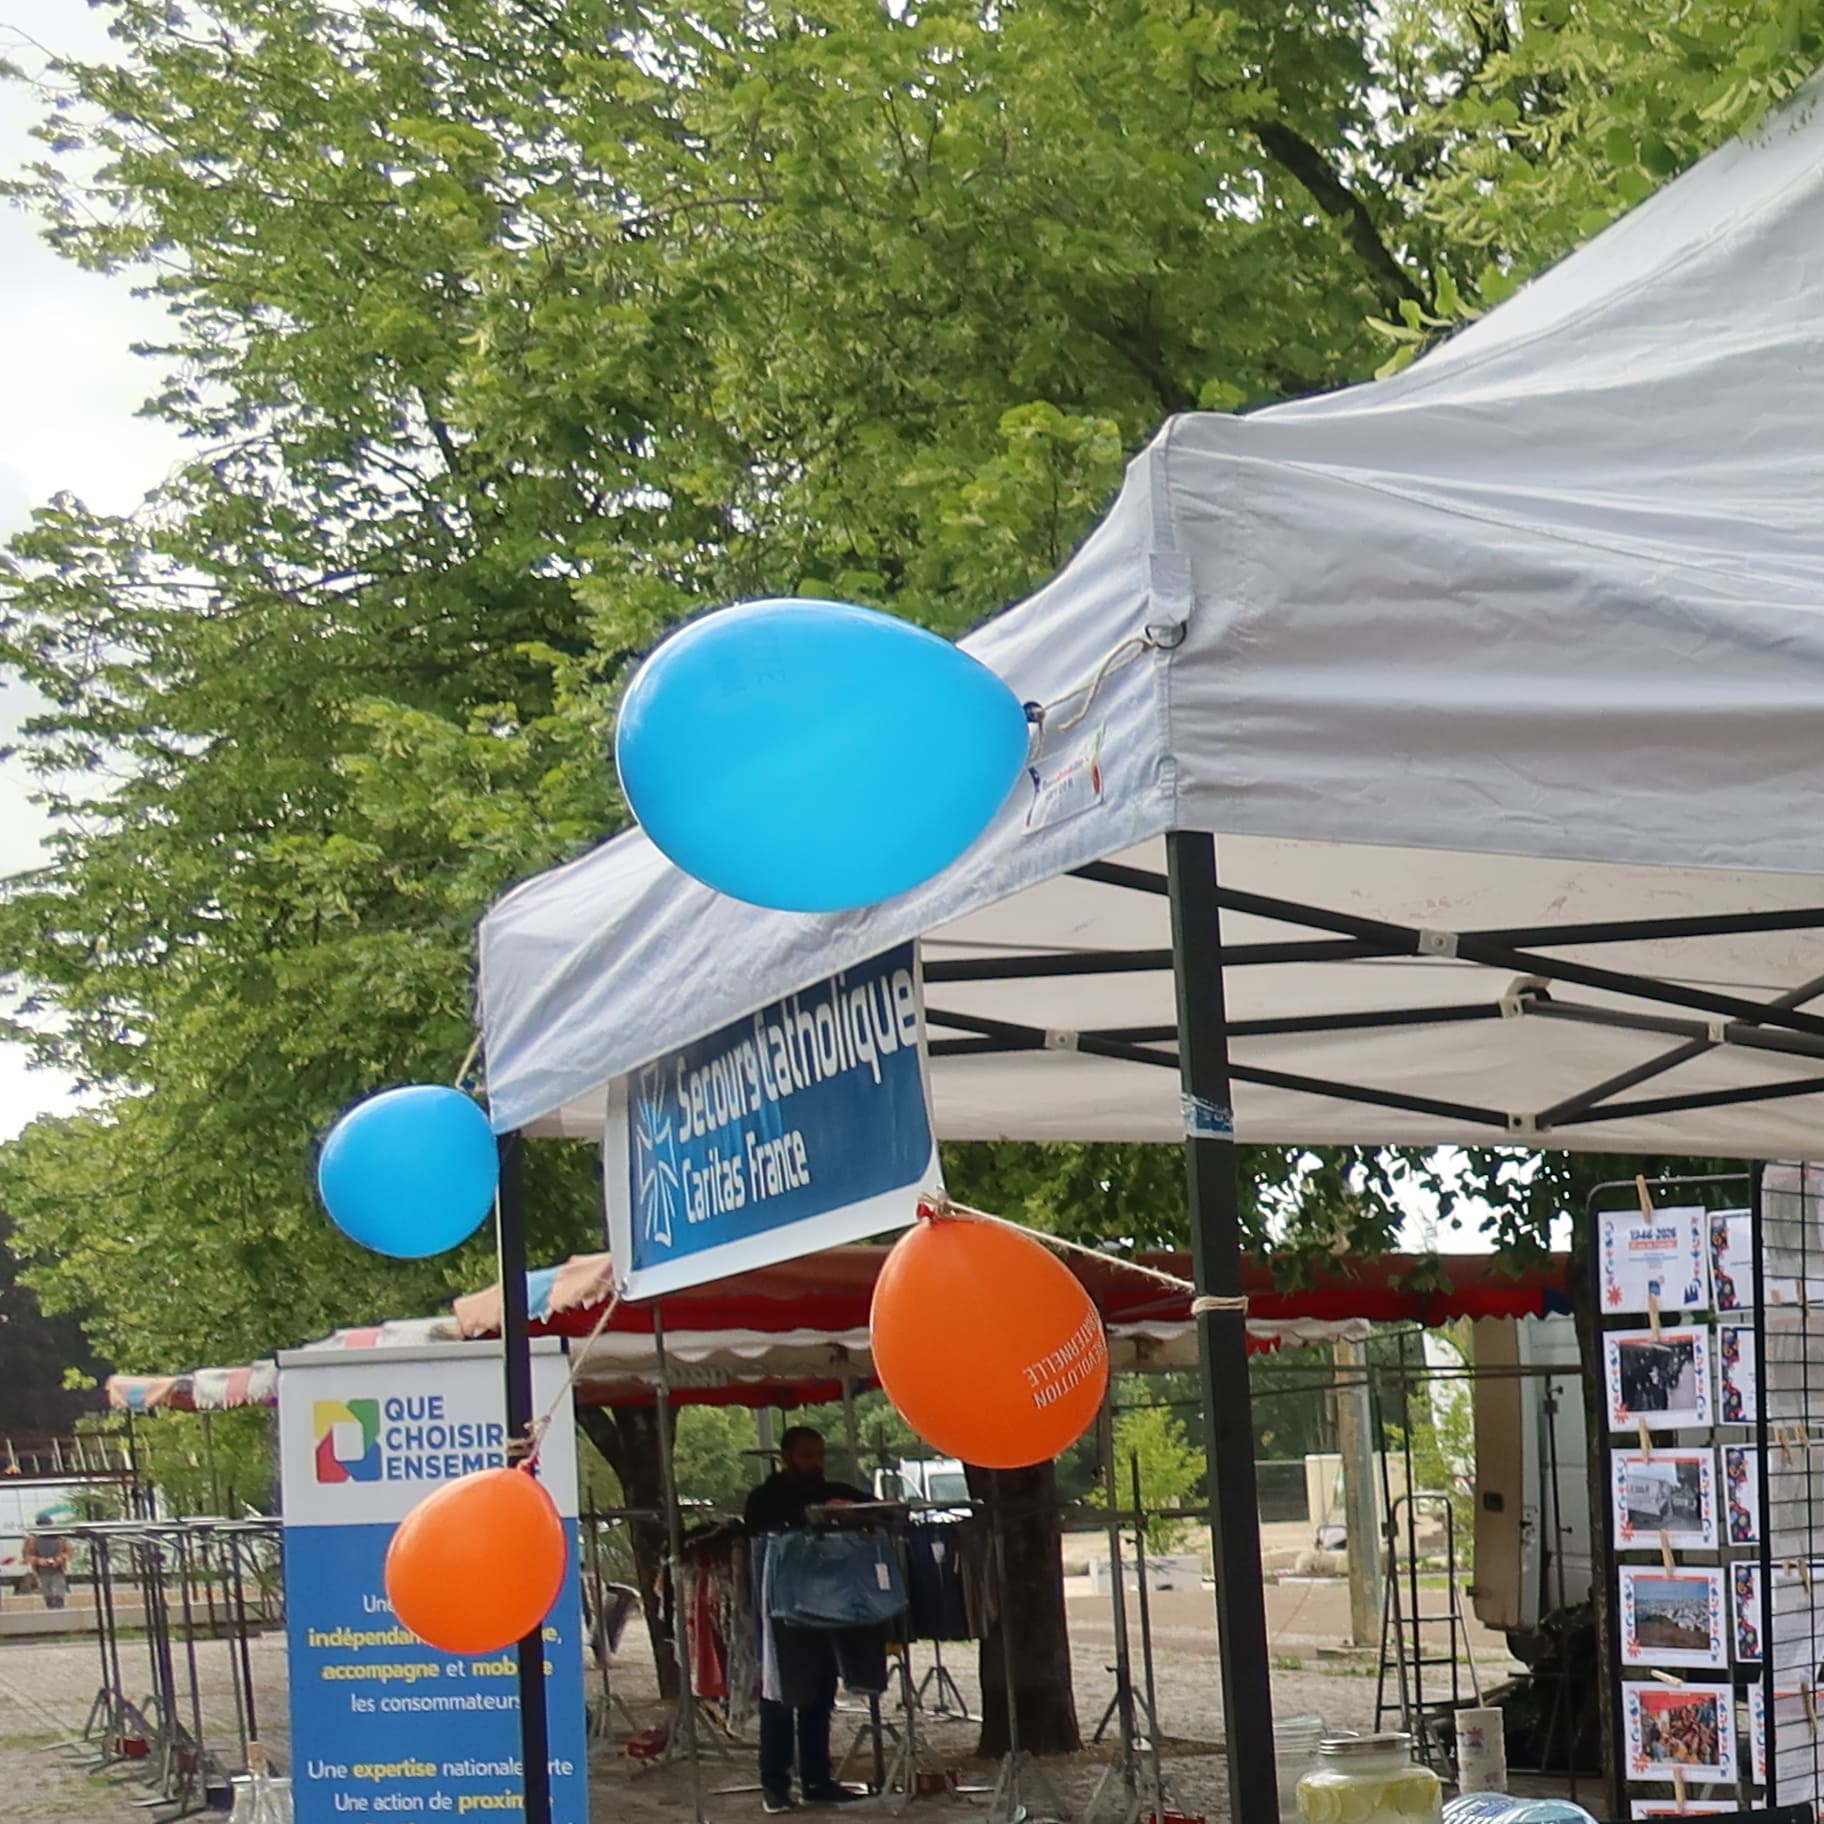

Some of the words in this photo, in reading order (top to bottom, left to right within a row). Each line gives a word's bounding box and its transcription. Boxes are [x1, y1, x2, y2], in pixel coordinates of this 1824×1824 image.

[676, 1040, 761, 1144] Secours
[754, 968, 920, 1103] Catholique
[681, 1145, 746, 1224] Caritas
[745, 1129, 811, 1203] France
[385, 1395, 445, 1422] QUE
[386, 1423, 504, 1451] CHOISIR
[386, 1452, 540, 1480] ENSEMB
[322, 1662, 440, 1684] accompagne
[447, 1659, 467, 1677] et
[351, 1693, 376, 1712] les
[307, 1760, 349, 1779] Une
[353, 1757, 438, 1782] expertise
[442, 1757, 524, 1777] nationale
[334, 1793, 369, 1811] Une
[373, 1791, 424, 1811] action
[428, 1790, 453, 1811] de
